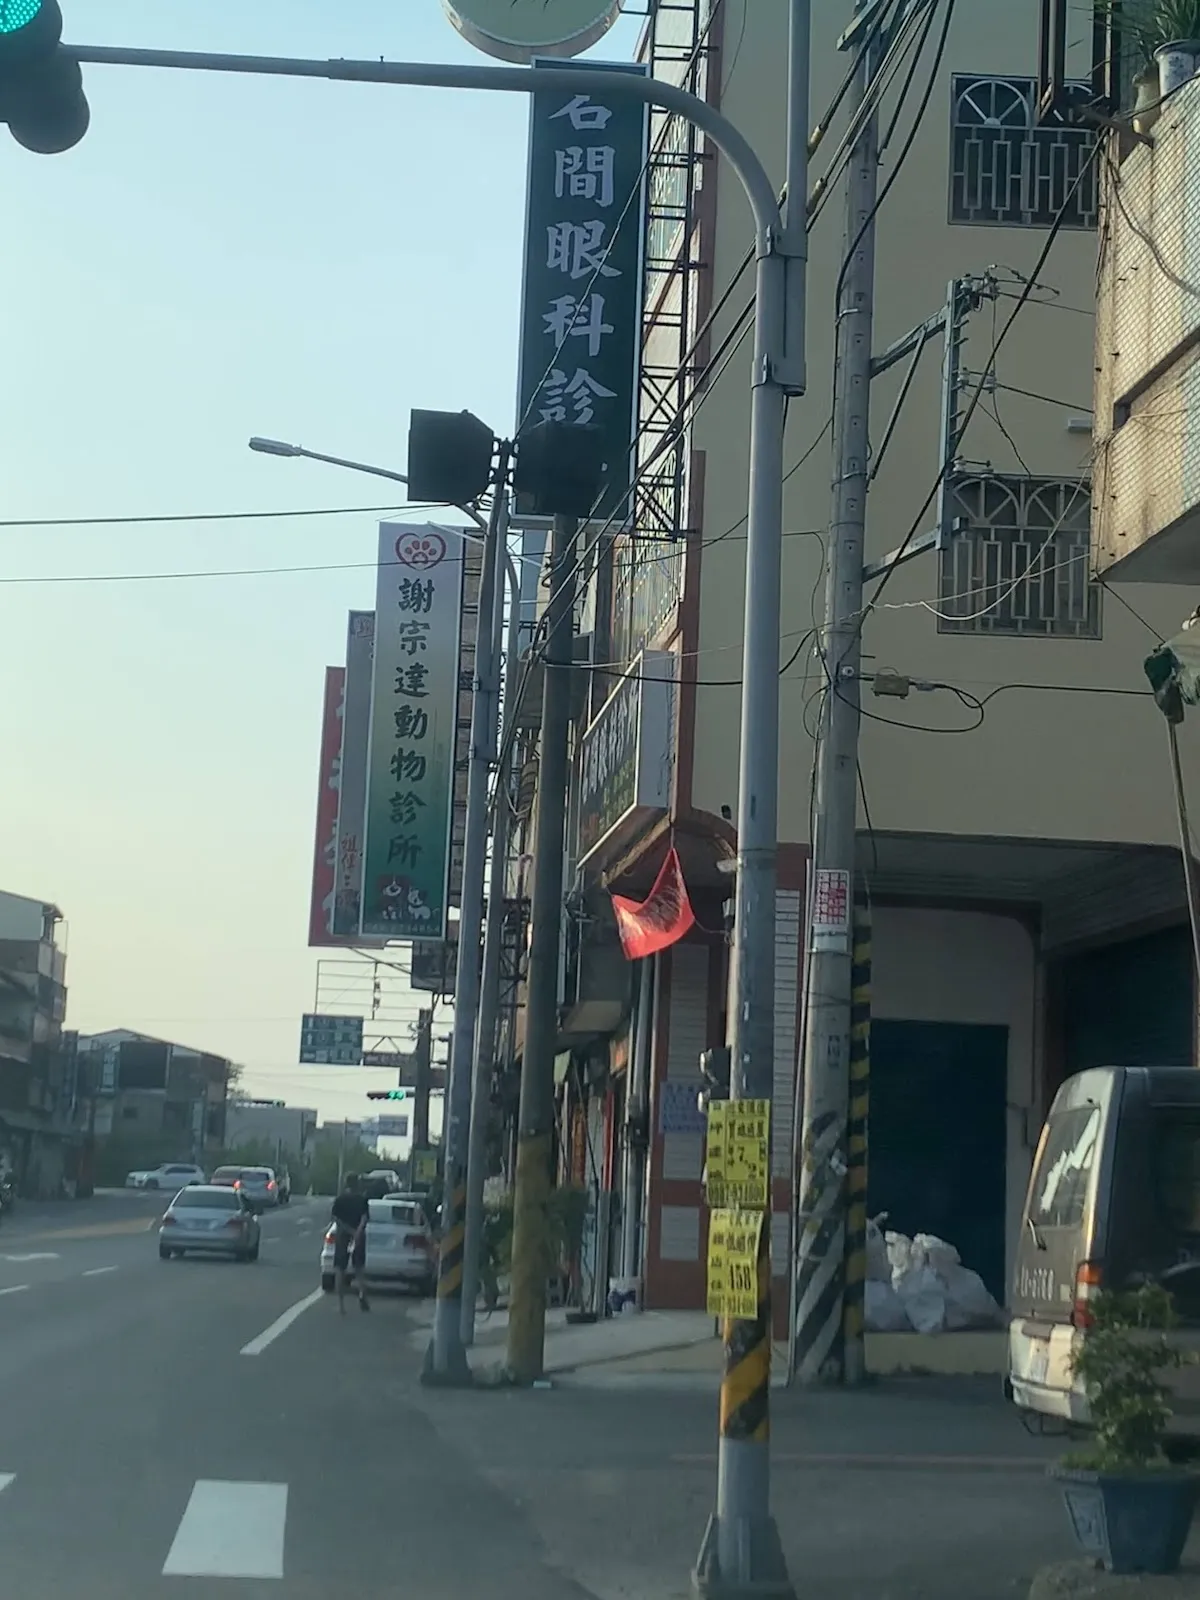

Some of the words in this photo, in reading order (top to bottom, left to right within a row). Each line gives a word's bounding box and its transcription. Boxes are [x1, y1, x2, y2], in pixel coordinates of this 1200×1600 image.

[387, 577, 436, 871] 謝宗達動物診所
